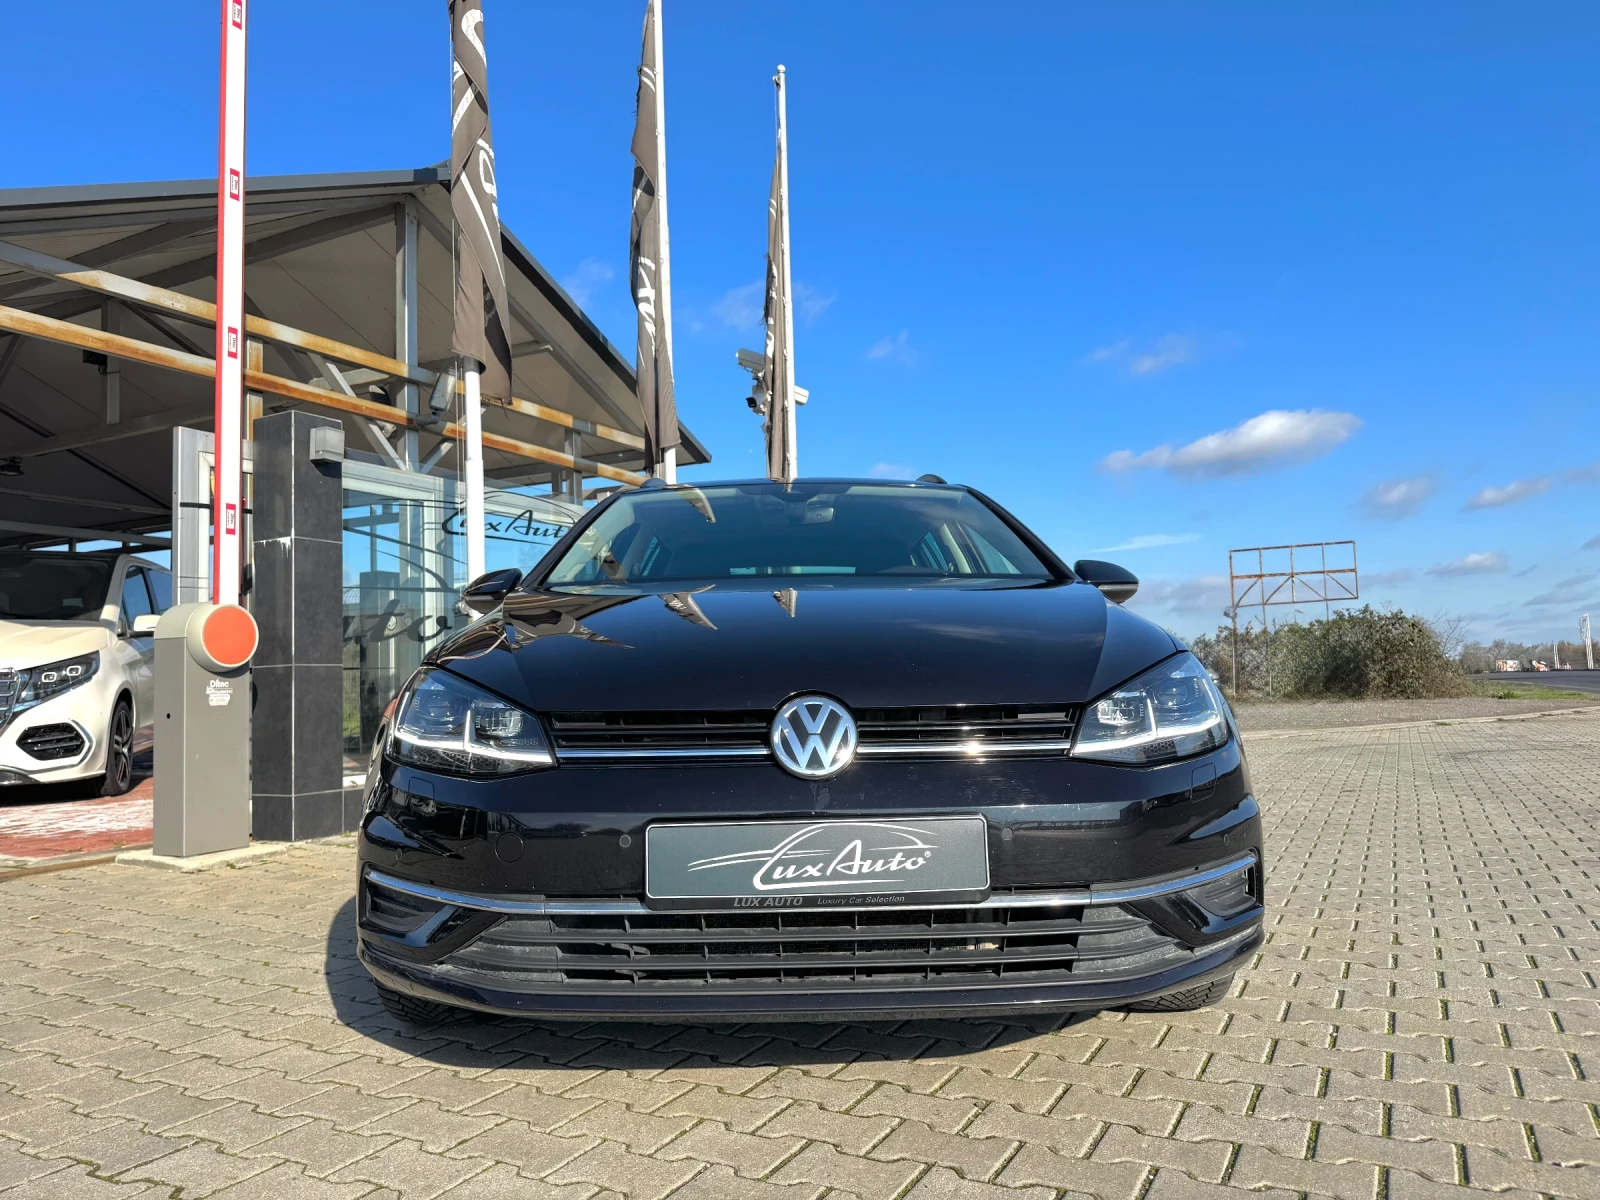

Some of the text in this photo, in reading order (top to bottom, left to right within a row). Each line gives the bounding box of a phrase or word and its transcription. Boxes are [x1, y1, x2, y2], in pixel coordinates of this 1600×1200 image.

[753, 839, 824, 890] Lux
[733, 896, 905, 908] LUX AUTO Luxury Car Selection
